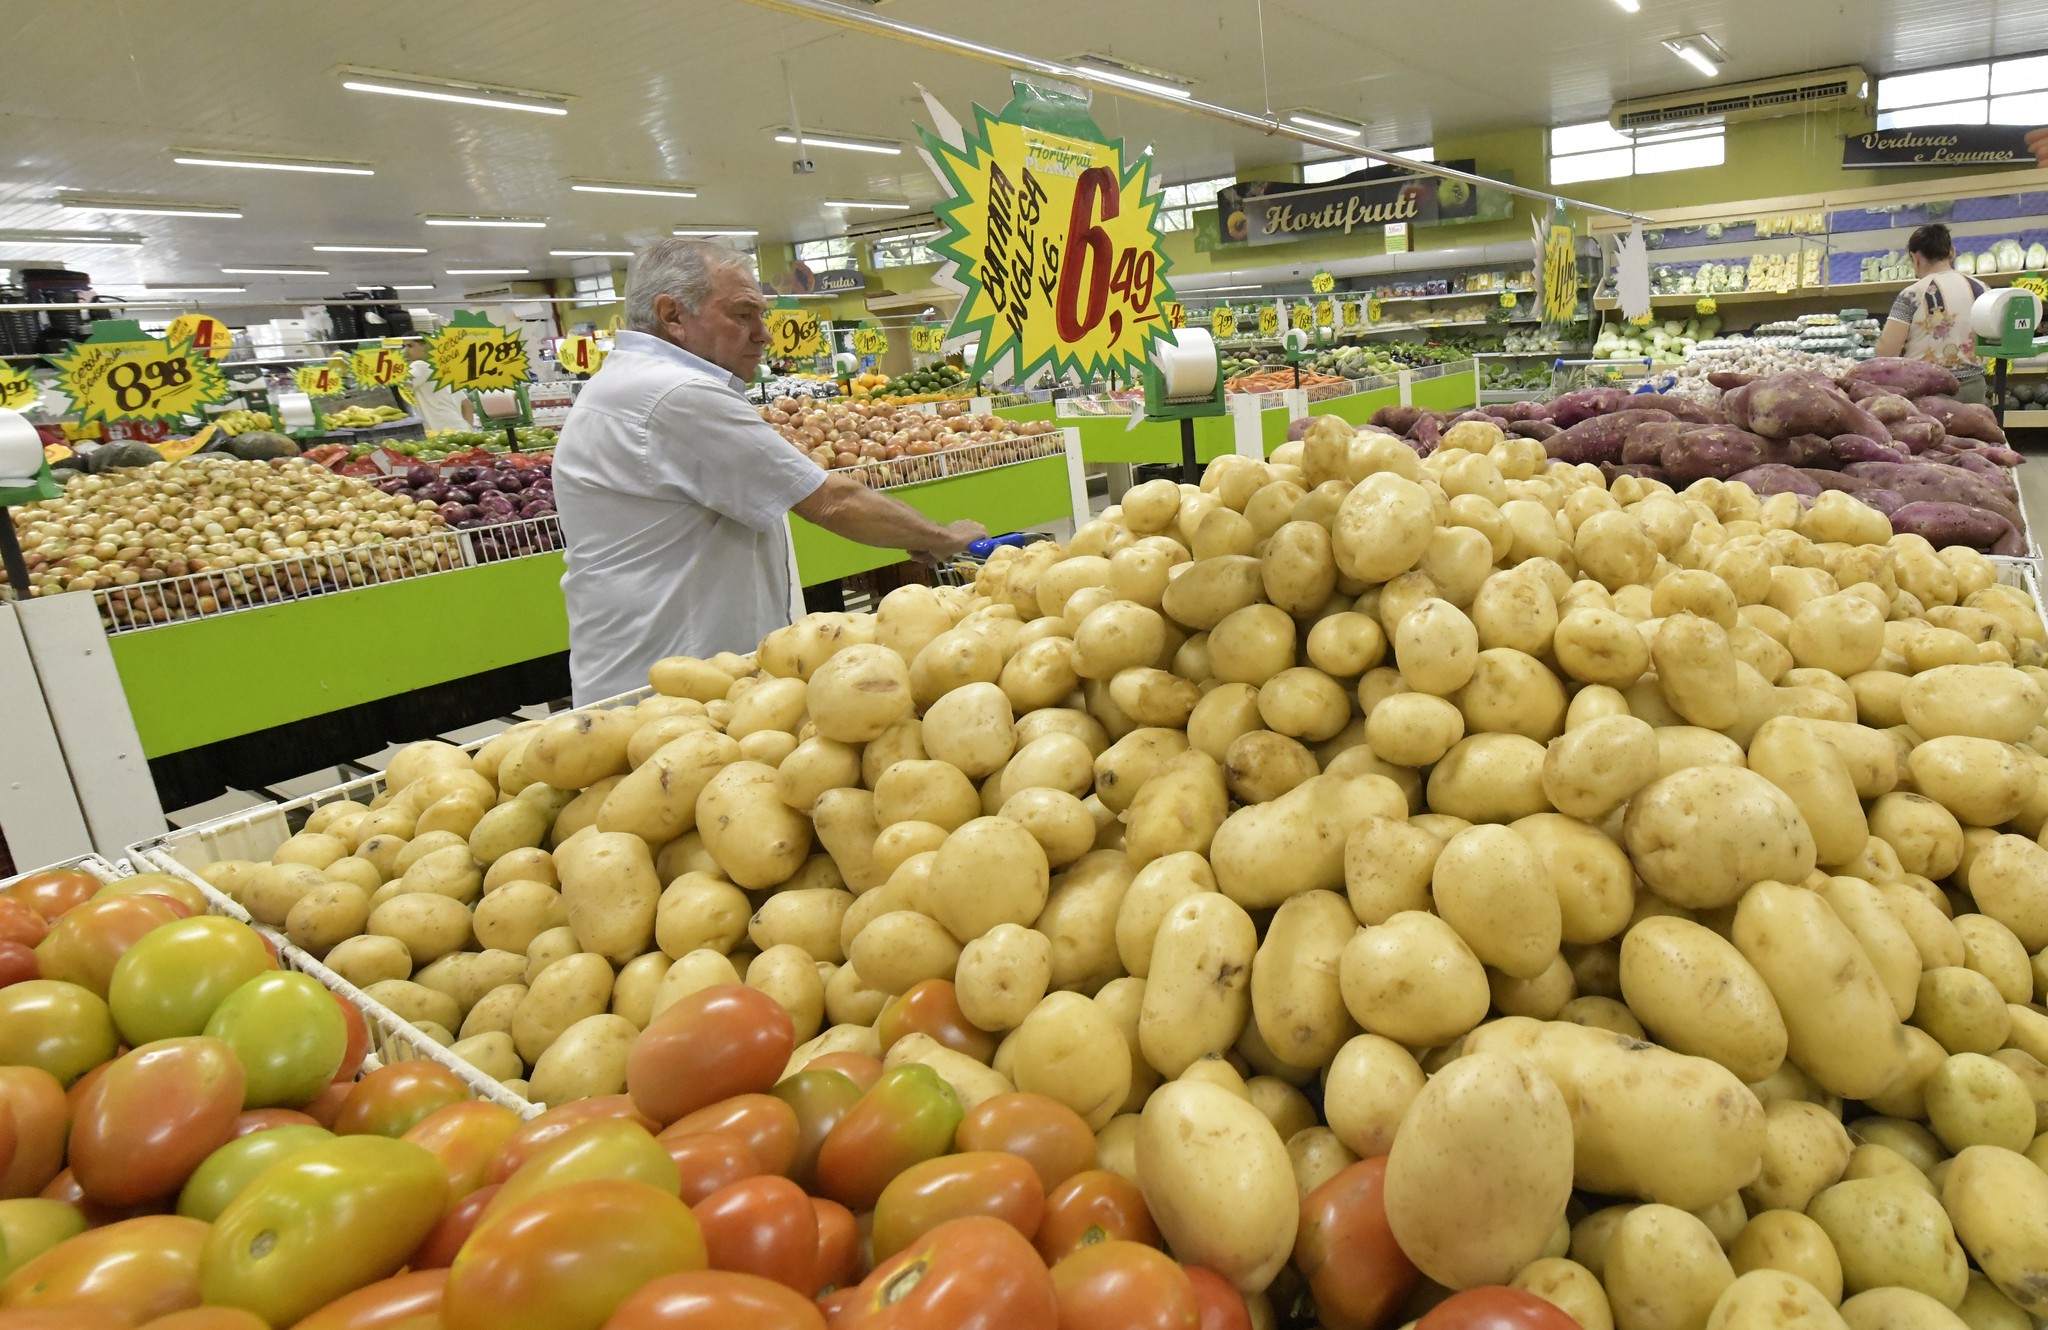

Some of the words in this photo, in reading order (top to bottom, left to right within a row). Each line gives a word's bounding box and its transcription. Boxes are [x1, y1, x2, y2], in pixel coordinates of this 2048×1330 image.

[1030, 139, 1092, 171] Hortifruti
[1862, 132, 1958, 150] Verduras
[1914, 153, 1924, 162] e
[1930, 148, 2014, 164] Legumes
[1262, 192, 1418, 236] Hortifruti
[981, 161, 1016, 313] BATATA
[1005, 167, 1048, 343] INGLESA
[821, 276, 857, 289] Frutas
